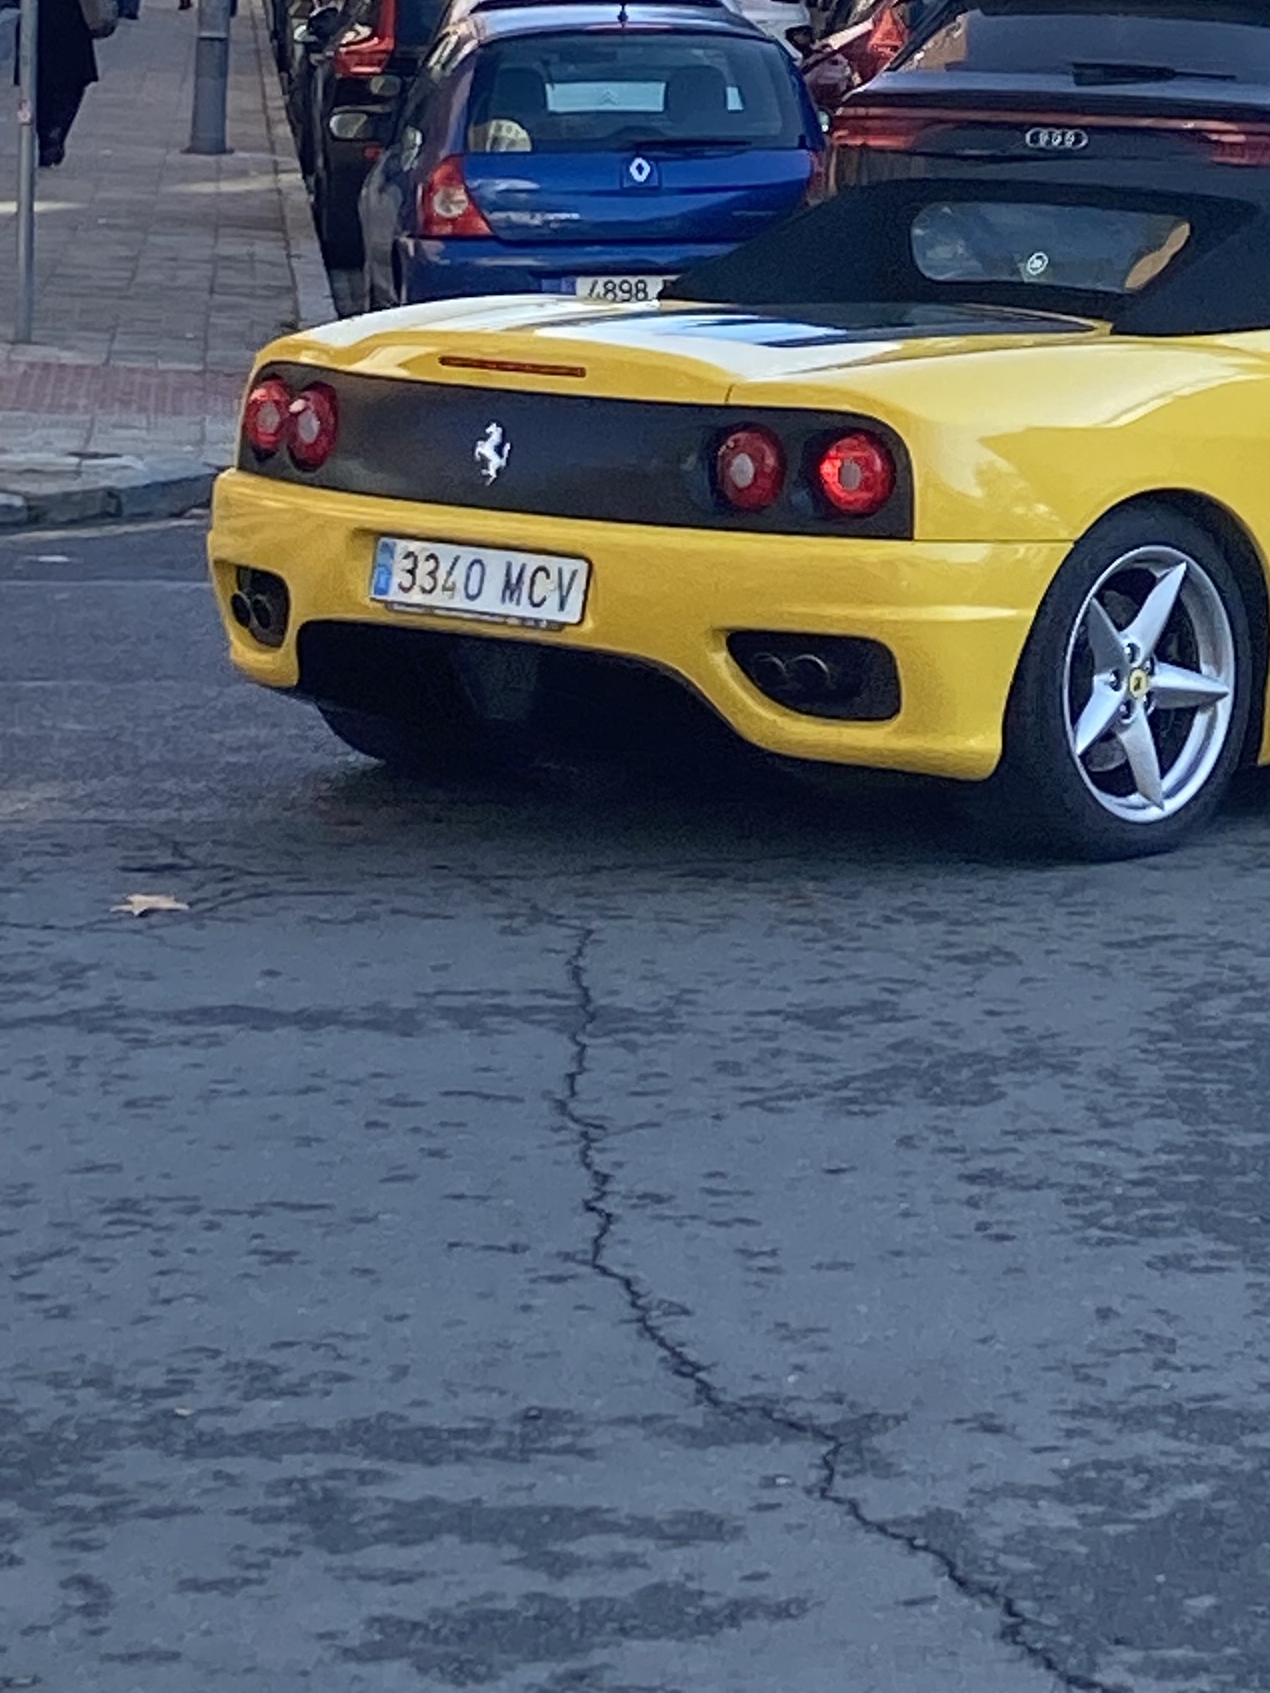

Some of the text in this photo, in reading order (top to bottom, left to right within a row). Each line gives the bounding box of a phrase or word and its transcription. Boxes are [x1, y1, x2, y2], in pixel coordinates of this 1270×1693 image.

[587, 279, 649, 303] 4898
[397, 550, 579, 613] 3340 MCV
